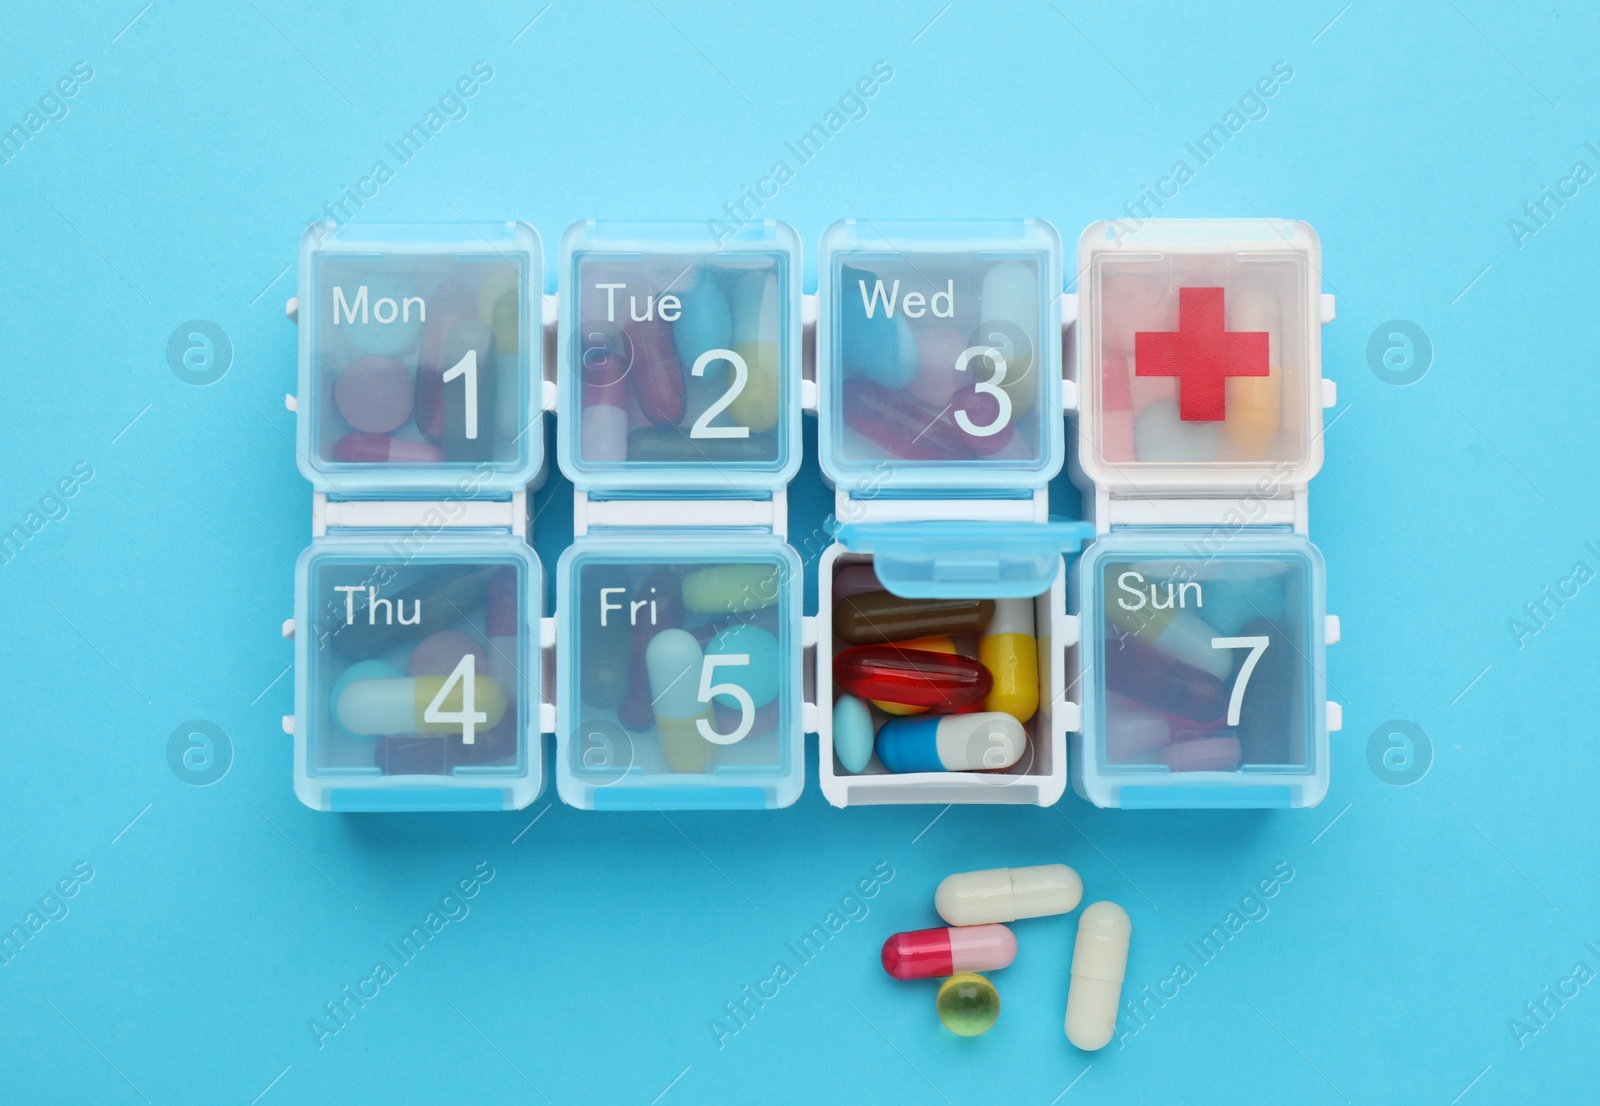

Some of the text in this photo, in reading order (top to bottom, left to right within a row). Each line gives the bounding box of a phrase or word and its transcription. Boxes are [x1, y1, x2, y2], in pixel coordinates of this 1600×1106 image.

[332, 285, 426, 325] Mon
[595, 283, 682, 322] Tue
[858, 279, 954, 319] Wed
[442, 349, 478, 440] 1
[689, 348, 750, 439] 2
[953, 345, 1013, 437] 3
[334, 585, 421, 625] Thu
[600, 587, 657, 626] Fri
[1117, 571, 1203, 611] Sun
[423, 653, 487, 745] 4
[695, 653, 756, 745] 5
[1211, 636, 1270, 726] 7
